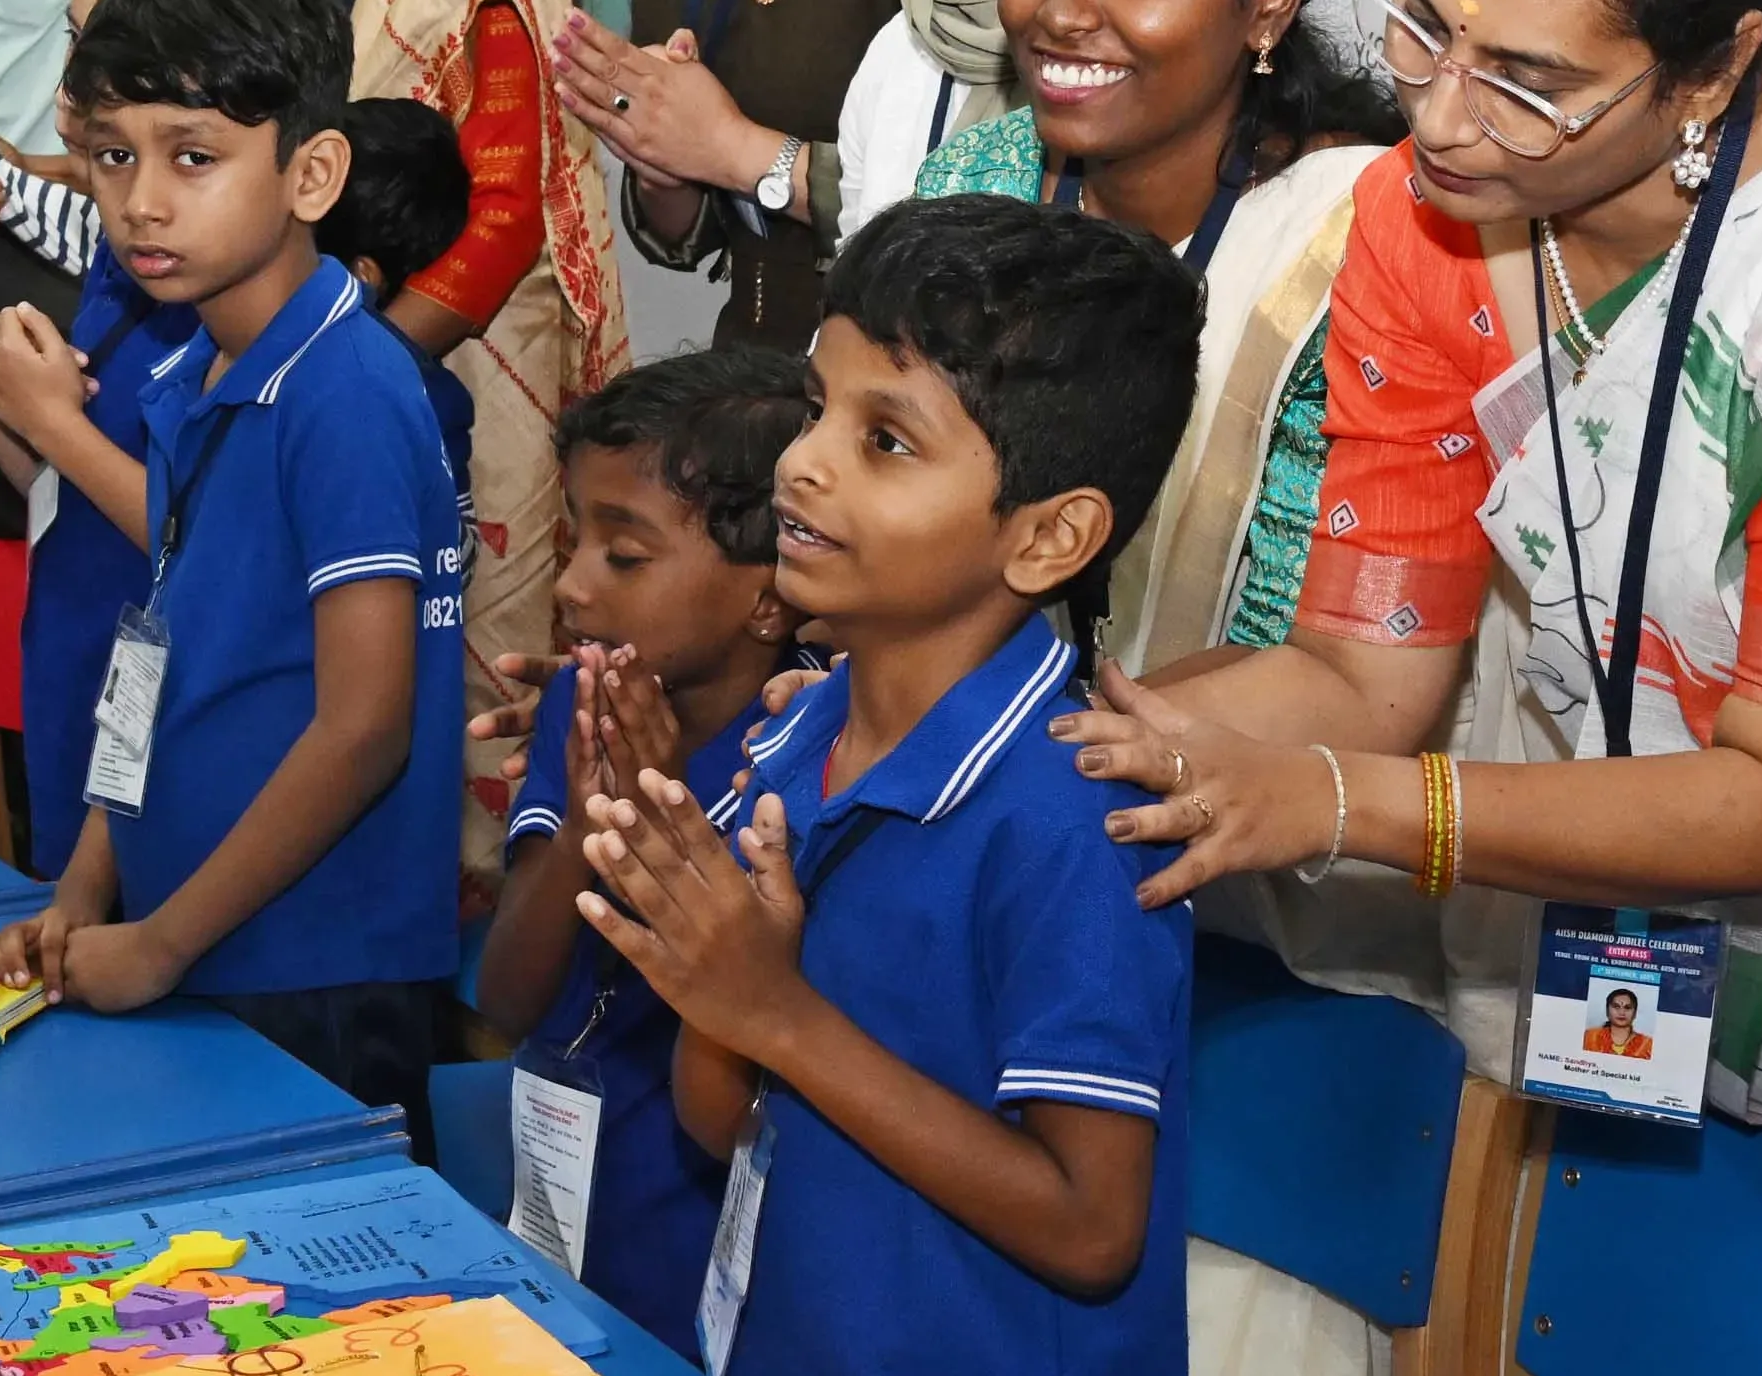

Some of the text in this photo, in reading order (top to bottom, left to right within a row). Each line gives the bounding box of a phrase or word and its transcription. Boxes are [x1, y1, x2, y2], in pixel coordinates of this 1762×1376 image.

[1577, 931, 1614, 943] DIAMOND
[1615, 935, 1646, 947] JUBILEE
[1648, 939, 1704, 955] CELEBRATIONS
[1564, 1064, 1588, 1073] Mother
